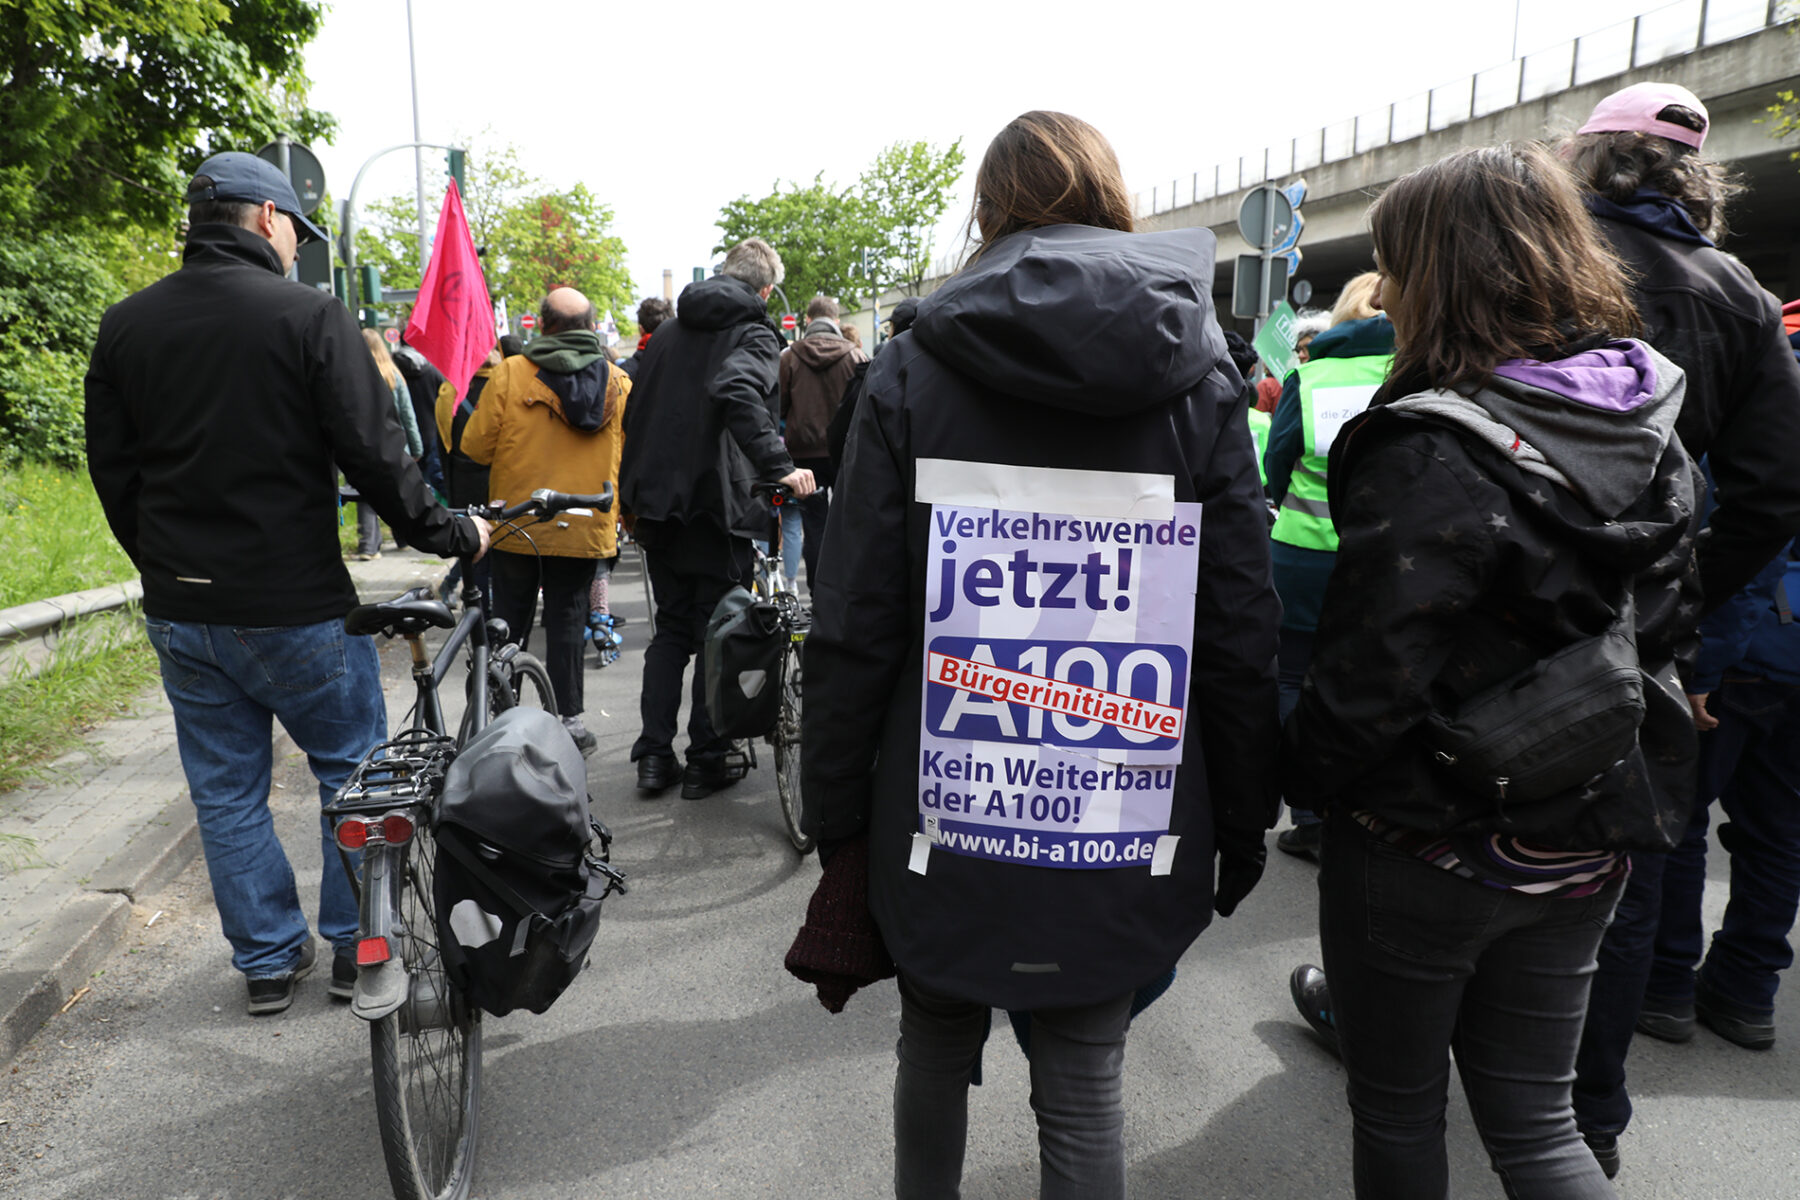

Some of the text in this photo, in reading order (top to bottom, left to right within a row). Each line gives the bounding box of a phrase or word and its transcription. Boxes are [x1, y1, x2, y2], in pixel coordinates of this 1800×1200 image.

[1321, 410, 1338, 420] die
[936, 509, 1197, 546] Verkehrswende
[929, 540, 1133, 623] jetzt!
[938, 644, 1173, 744] A100
[938, 657, 1178, 734] Bürgerinitiative
[922, 749, 1173, 792] Kein Weiterbau
[922, 783, 1082, 824] der A100!
[938, 828, 1153, 863] www.bi-a100.de
